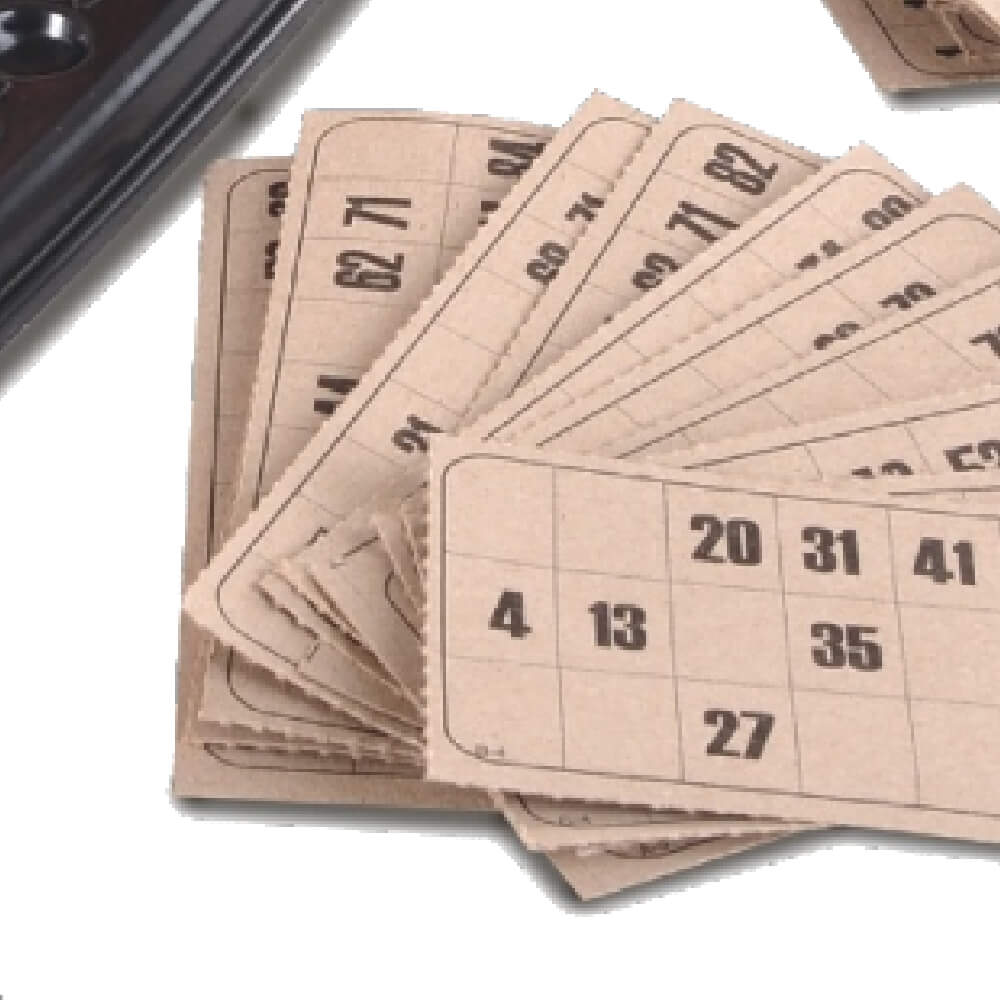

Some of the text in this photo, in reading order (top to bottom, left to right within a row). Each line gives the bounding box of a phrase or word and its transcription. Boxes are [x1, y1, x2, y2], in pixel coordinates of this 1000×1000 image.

[342, 196, 412, 231] 71
[664, 200, 741, 247] 71
[703, 142, 779, 196] 82
[332, 249, 405, 293] 62
[690, 513, 763, 567] 20
[800, 526, 860, 576] 31
[913, 536, 977, 586] 41
[487, 590, 533, 640] 4
[587, 600, 647, 651] 13
[810, 623, 883, 673] 35
[703, 707, 776, 760] 27
